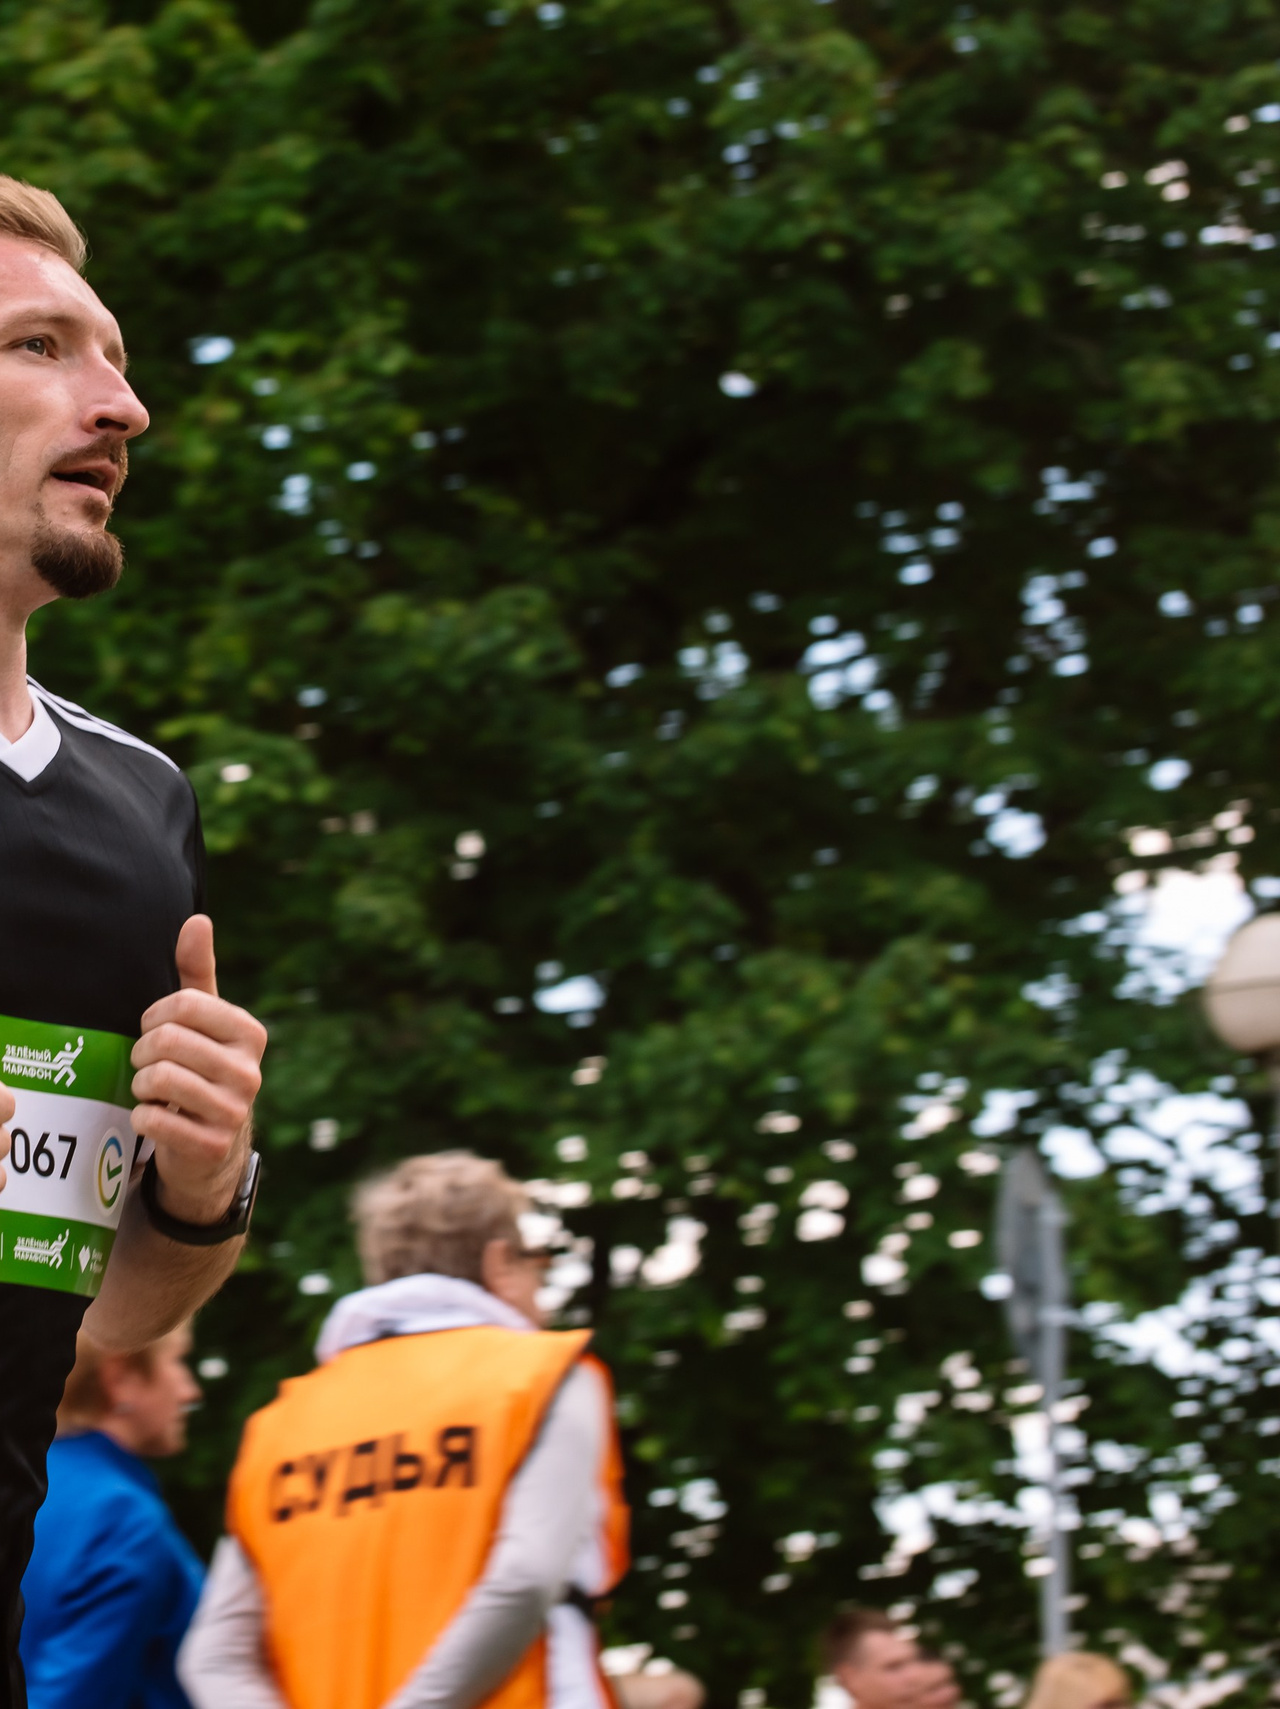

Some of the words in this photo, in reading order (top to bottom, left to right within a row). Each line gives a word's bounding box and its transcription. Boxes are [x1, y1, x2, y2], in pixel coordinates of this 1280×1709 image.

[5, 1044, 52, 1062] ЗЕЛЁНЫЙ
[2, 1062, 52, 1080] МАРАФОН
[10, 1128, 77, 1180] 067
[14, 1250, 49, 1264] МАРАФОН
[269, 1425, 478, 1525] СУДЬЯ
